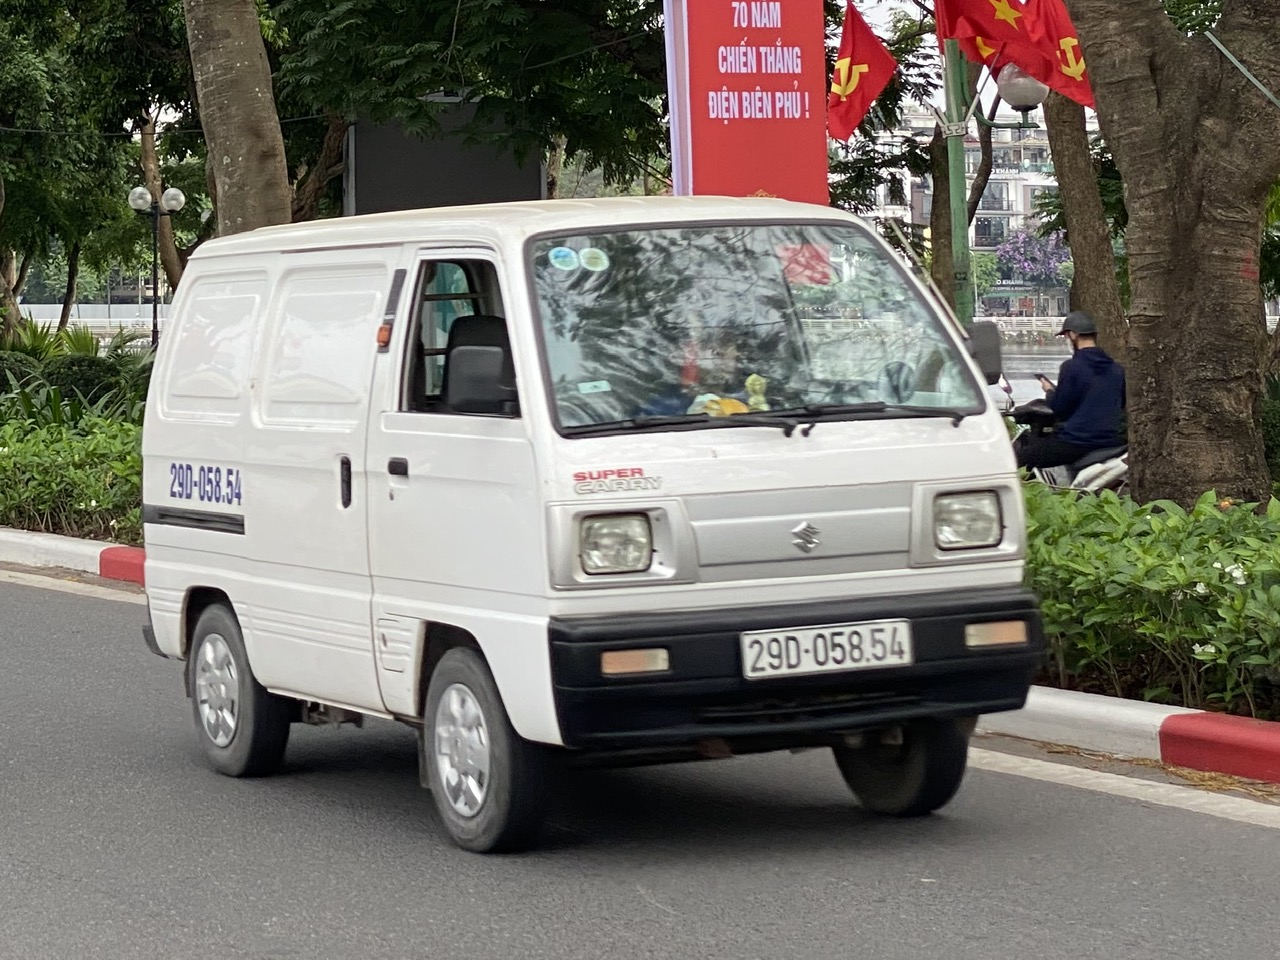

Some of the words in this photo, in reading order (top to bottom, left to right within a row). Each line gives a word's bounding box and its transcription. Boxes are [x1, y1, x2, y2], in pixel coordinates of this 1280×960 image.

[731, 1, 748, 28] 70
[718, 36, 757, 74] CHIẾN
[759, 37, 802, 74] THẮNG
[708, 85, 739, 125] ĐIỆN
[742, 85, 772, 119] BIÊN
[775, 80, 801, 119] PHỦ
[169, 462, 242, 506] 29D-058.54
[573, 467, 644, 481] SUPER
[574, 476, 662, 495] CARRY
[748, 626, 905, 673] 29D-058.54
